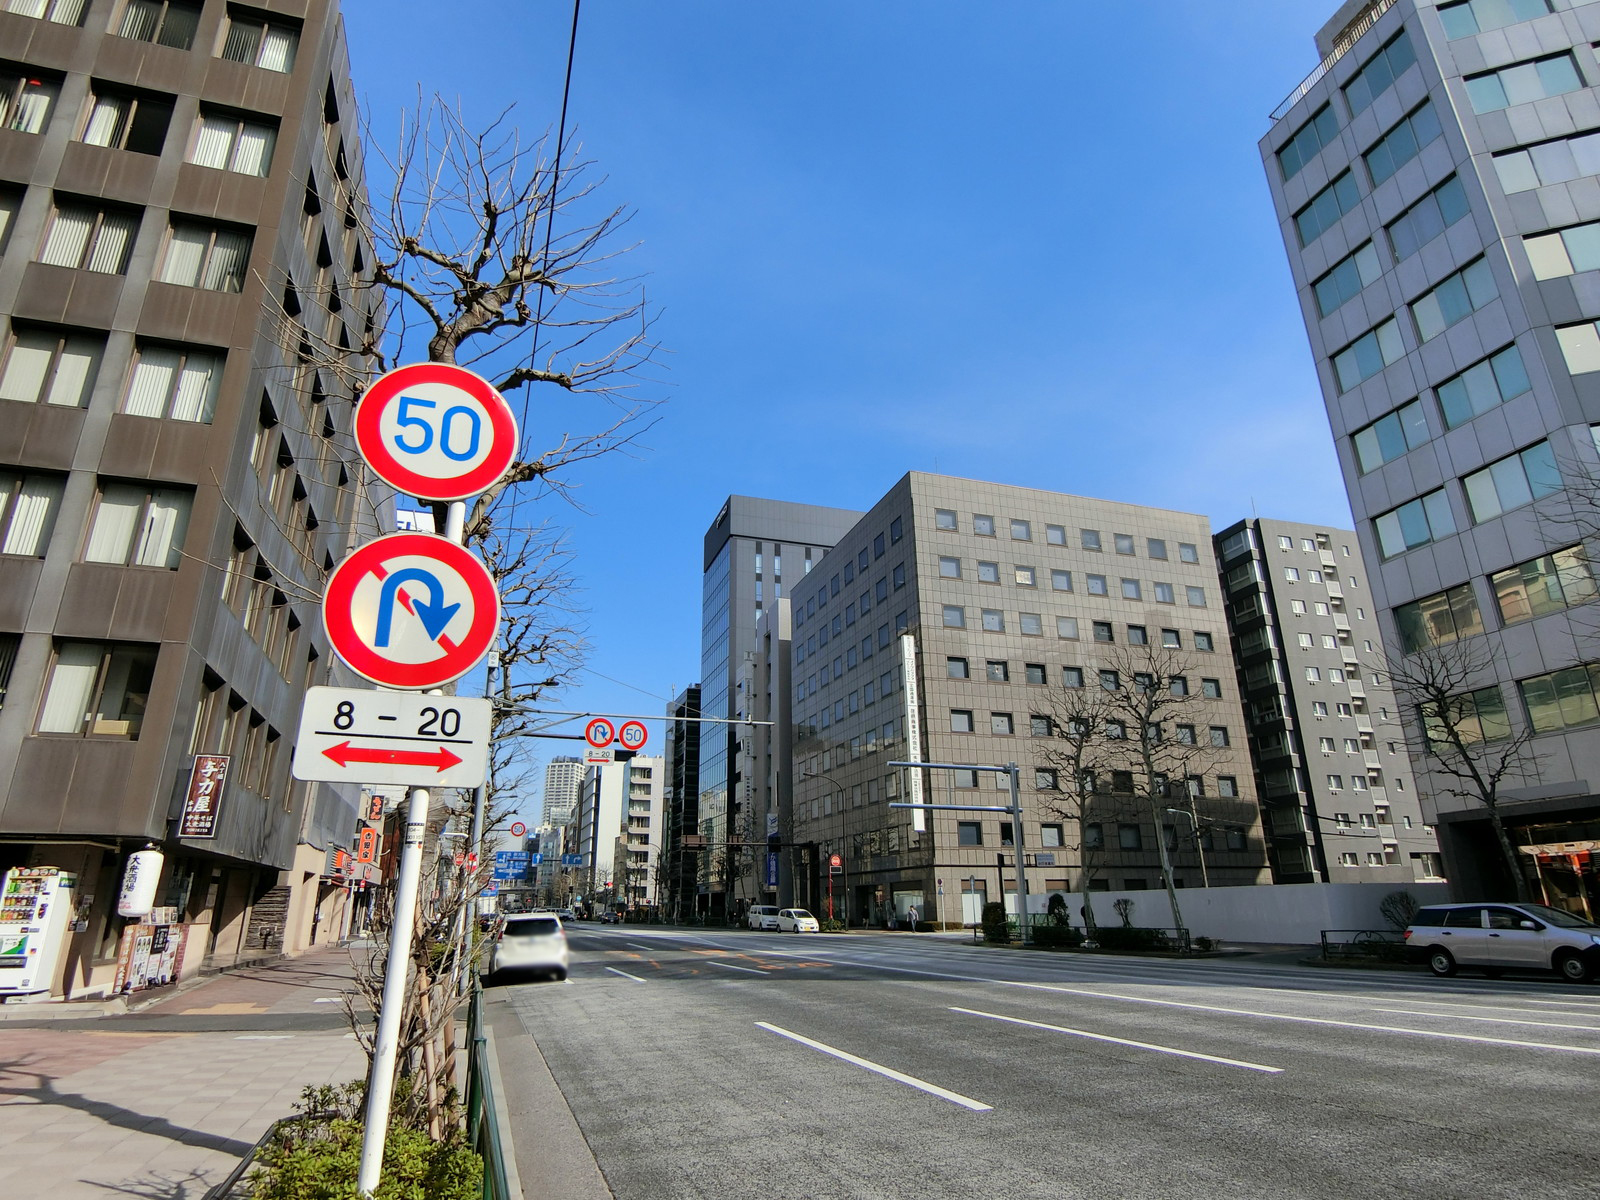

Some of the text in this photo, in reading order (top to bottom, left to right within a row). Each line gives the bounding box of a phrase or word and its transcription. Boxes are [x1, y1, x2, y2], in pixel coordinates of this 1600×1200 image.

[394, 396, 481, 462] 50
[333, 700, 355, 730] 8
[417, 707, 461, 737] 20
[626, 729, 642, 742] 50
[193, 761, 218, 812] 与力屋
[124, 855, 141, 892] 大衆酒場
